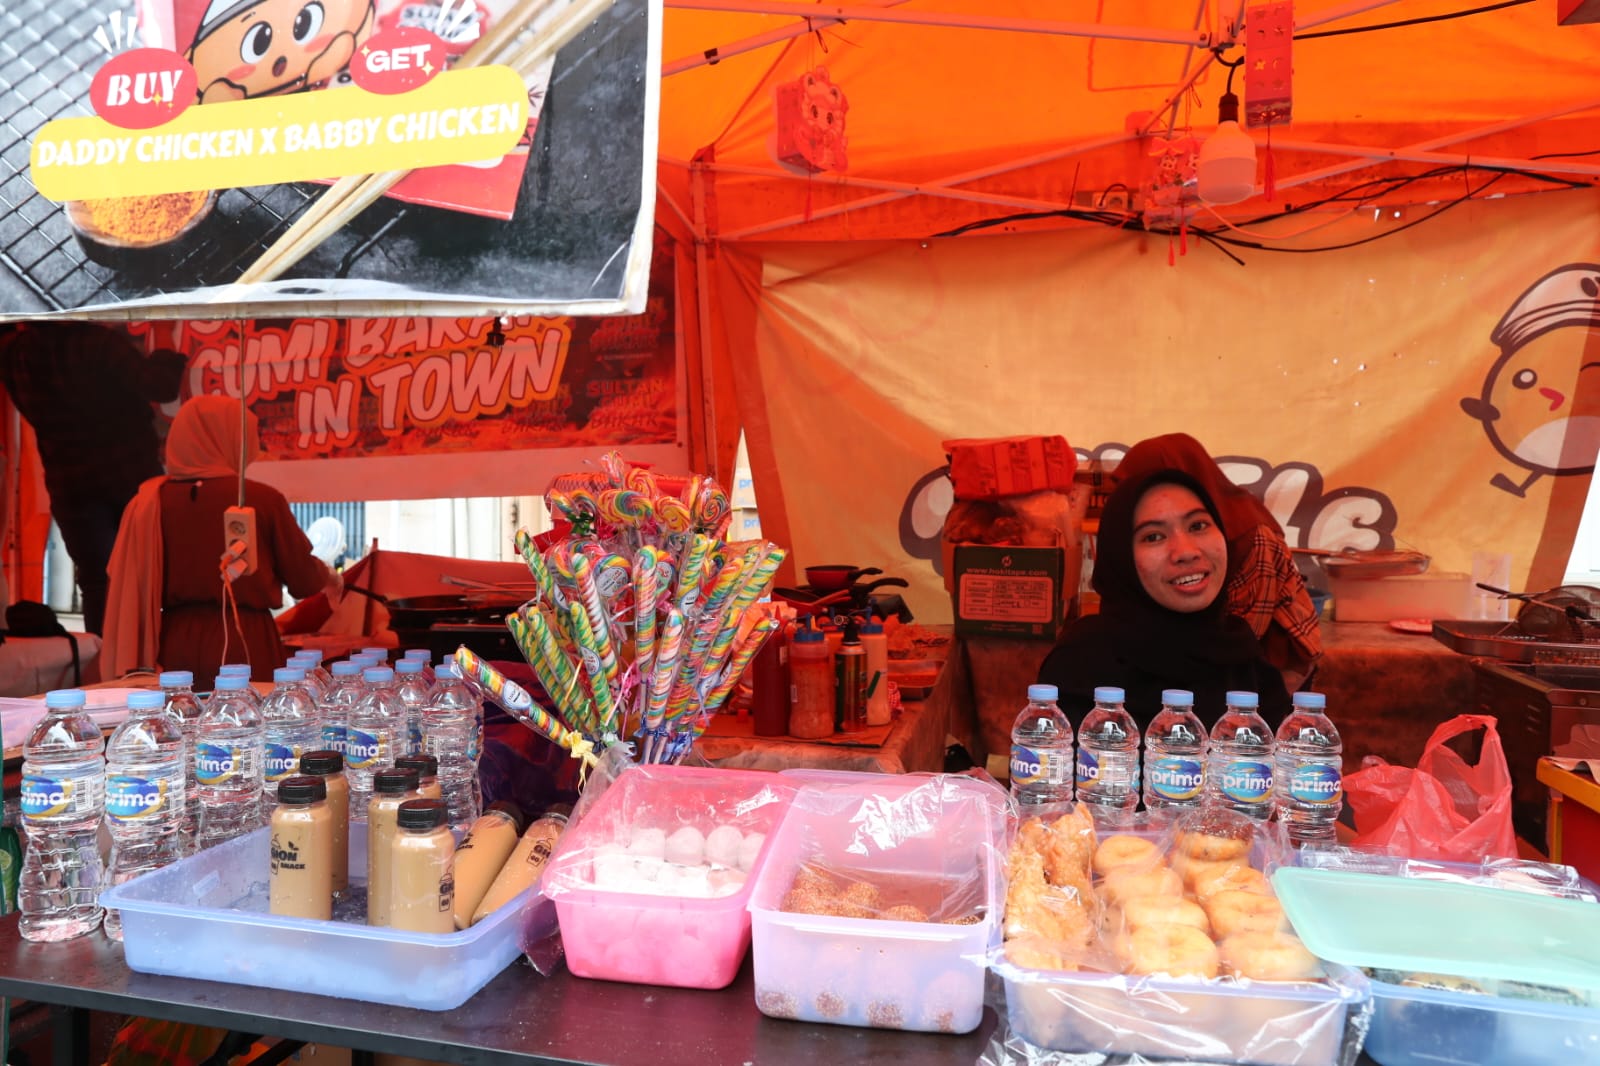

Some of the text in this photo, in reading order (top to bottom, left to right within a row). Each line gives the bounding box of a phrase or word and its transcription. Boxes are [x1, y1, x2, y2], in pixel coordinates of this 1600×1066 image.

[365, 43, 432, 74] GET
[105, 69, 184, 107] BUY
[37, 100, 521, 168] DADDY CHICKEN X BABBY CHICKEN
[188, 319, 330, 400] CUMI
[297, 378, 355, 449] IN
[369, 327, 563, 430] TOWN
[1151, 769, 1203, 787] prima
[1223, 772, 1274, 790] prima
